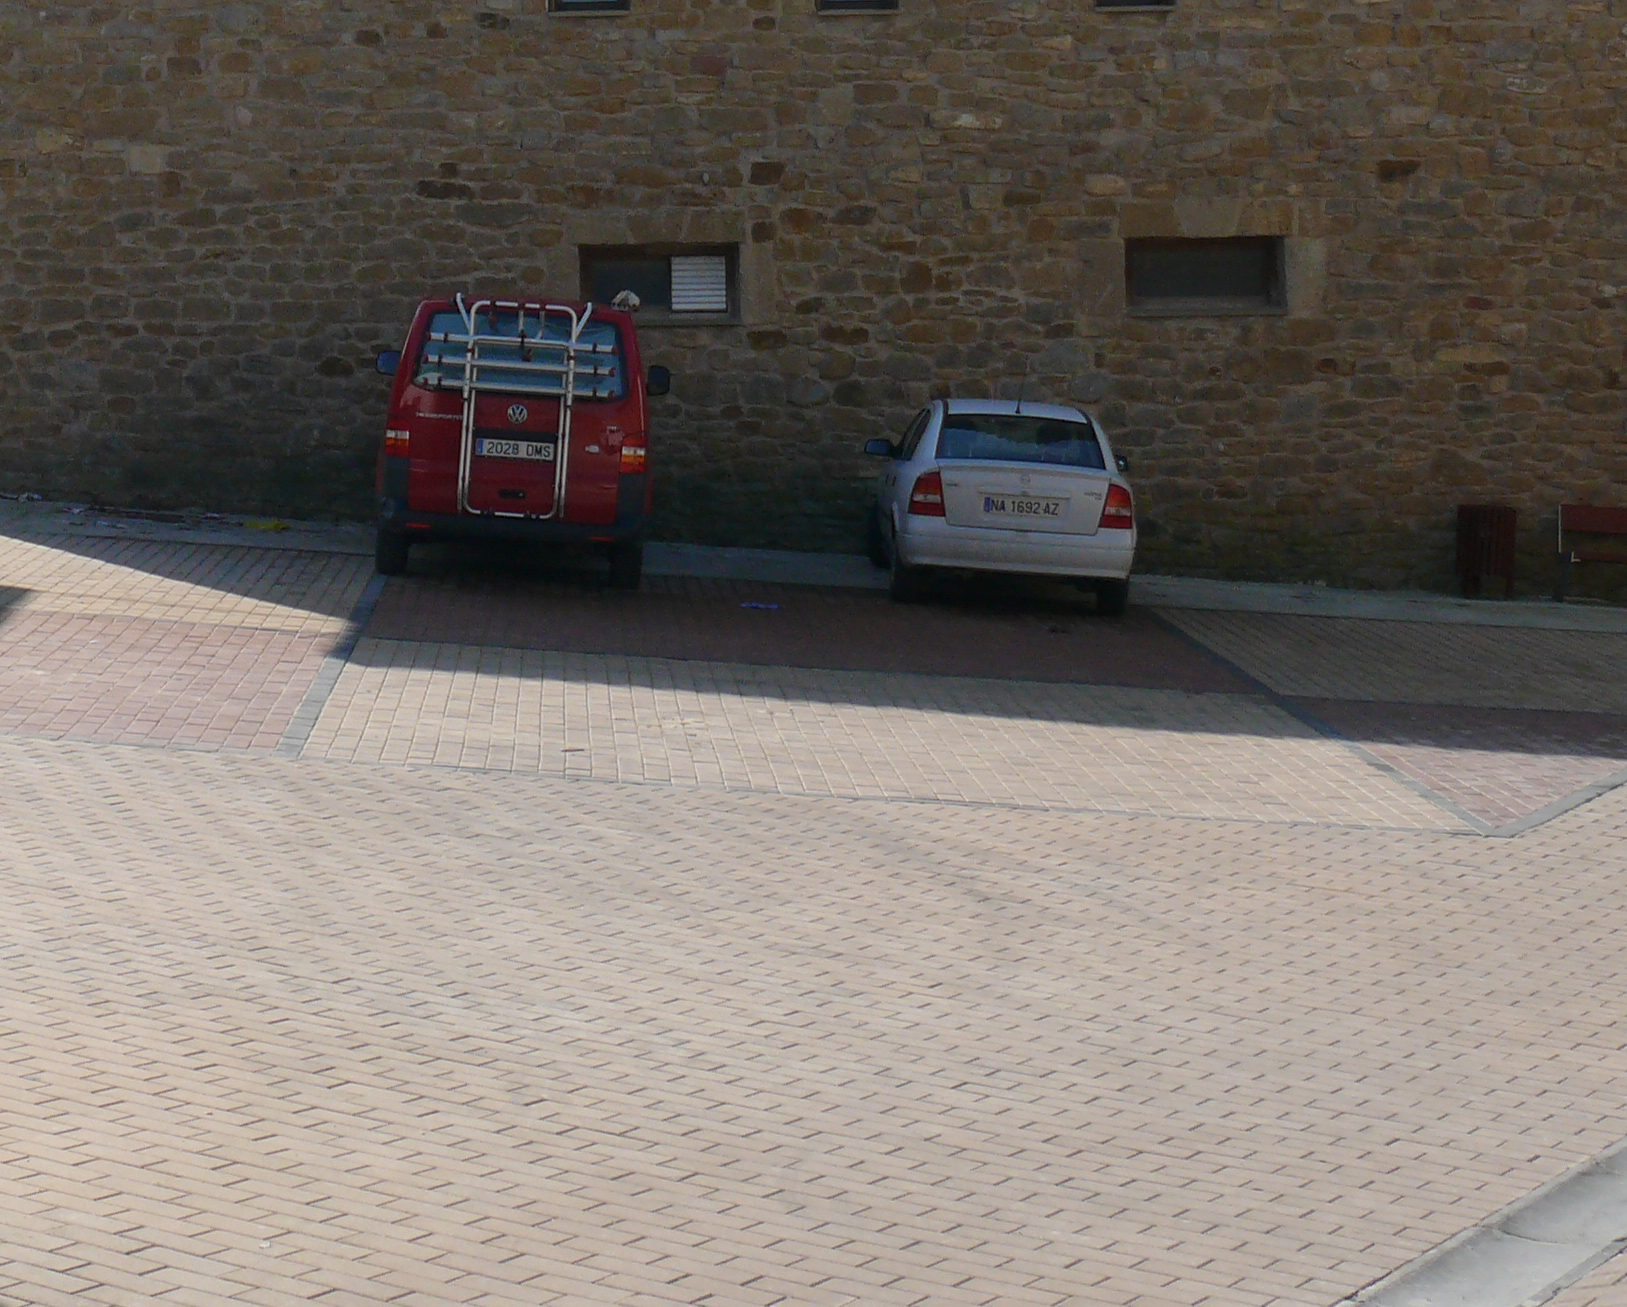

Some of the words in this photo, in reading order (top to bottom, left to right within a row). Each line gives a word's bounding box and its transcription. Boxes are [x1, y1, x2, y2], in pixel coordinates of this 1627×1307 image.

[486, 441, 519, 456] 2028
[526, 444, 551, 458] DMS
[990, 499, 1006, 512] NA
[1011, 500, 1041, 515] 1692
[1042, 502, 1060, 516] AZ
